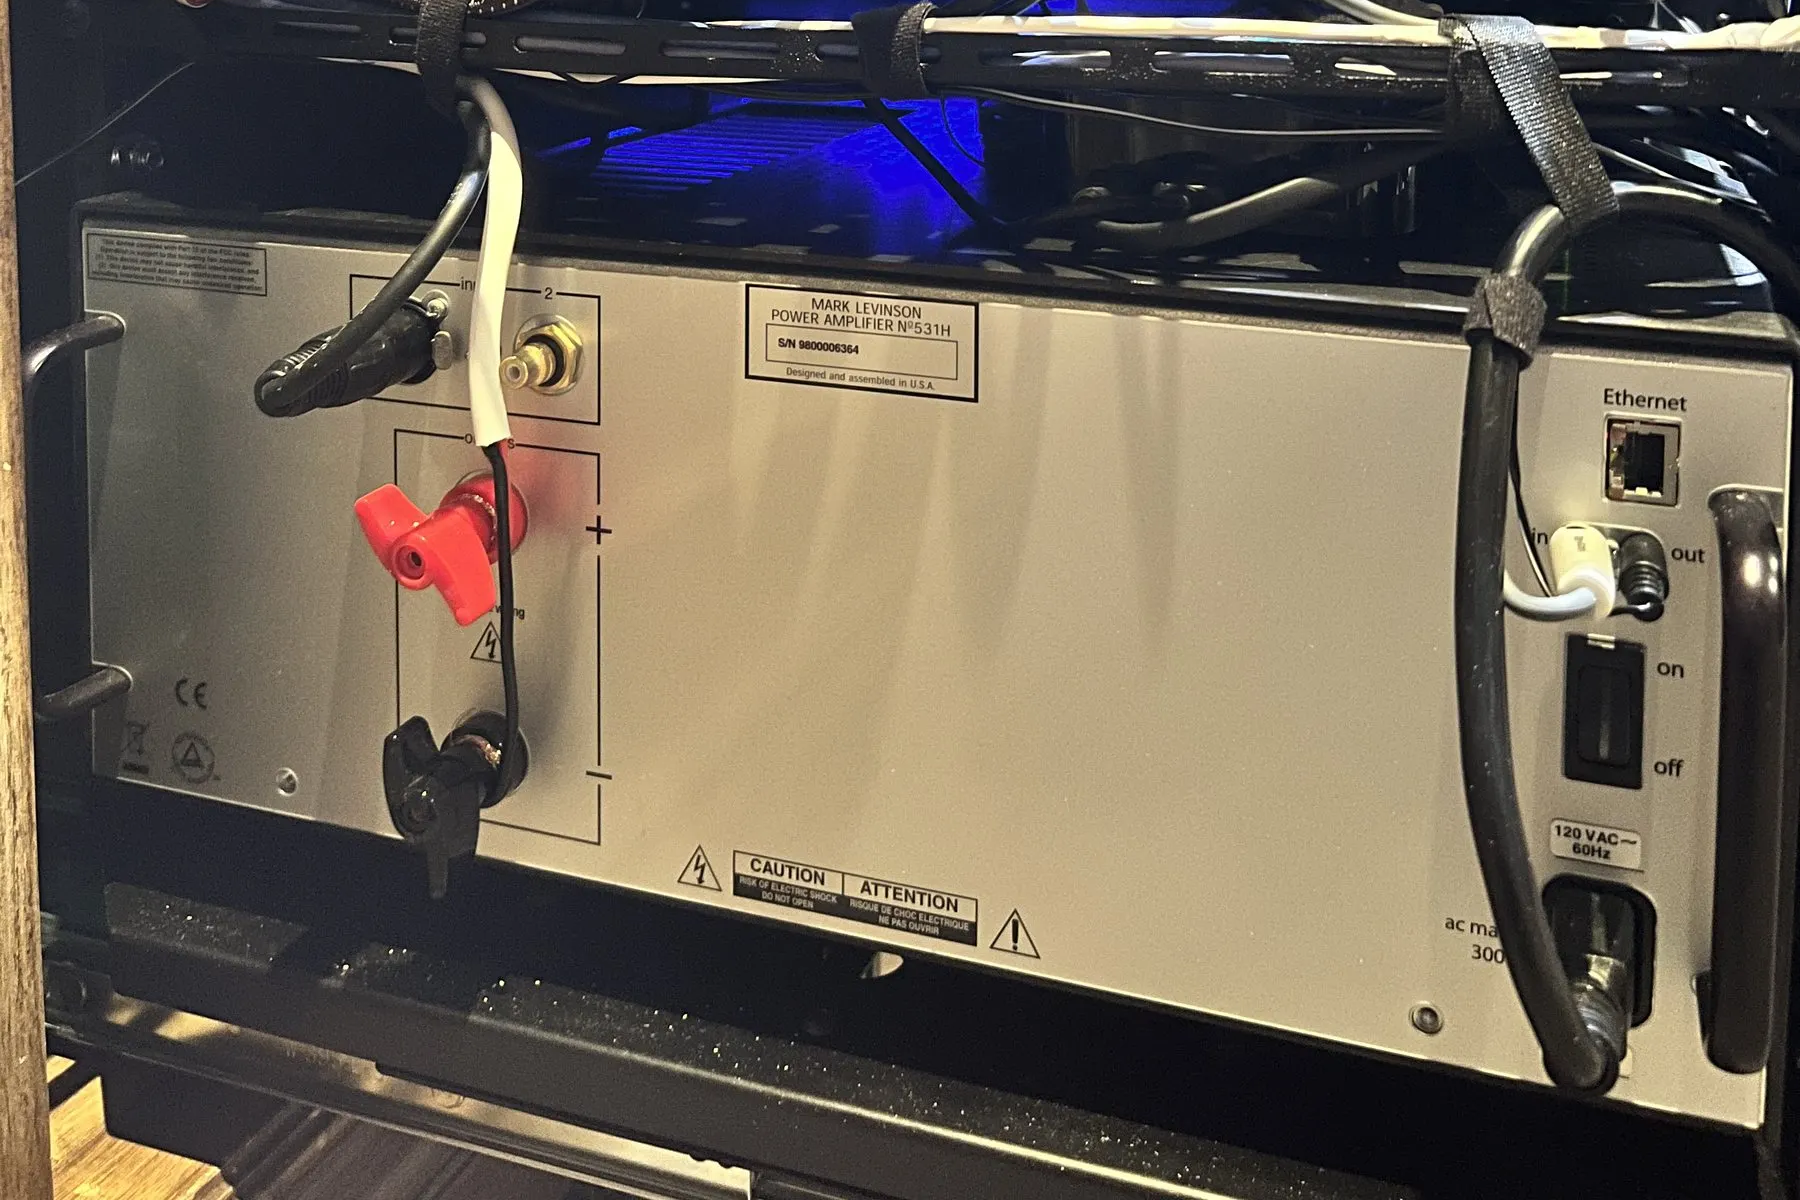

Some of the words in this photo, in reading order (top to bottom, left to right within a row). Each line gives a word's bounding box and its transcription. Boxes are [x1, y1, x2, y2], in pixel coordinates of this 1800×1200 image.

[544, 287, 553, 300] 2
[811, 298, 850, 314] MARK
[855, 301, 922, 319] LEVINSON
[771, 309, 819, 325] POWER
[824, 313, 894, 332] AMPLIFIER
[778, 337, 796, 350] S/N
[798, 339, 860, 355] 9800006364
[786, 366, 827, 381] Designed
[829, 370, 846, 382] and
[849, 372, 896, 388] assembled
[898, 377, 908, 388] in
[910, 377, 935, 391] U.S.A.
[1603, 387, 1688, 412] Ethernet
[1671, 547, 1706, 563] out
[1656, 660, 1685, 679] on
[1653, 757, 1685, 777] off
[1554, 824, 1581, 840] 120
[1572, 842, 1611, 860] 60Hz
[750, 858, 825, 886] CAUTION
[740, 875, 757, 888] RISK
[759, 880, 769, 890] OF
[771, 882, 808, 897] ELECTRIC
[810, 890, 838, 904] SHOCK
[860, 880, 958, 913] ATTENTION
[762, 891, 773, 900] DO
[774, 893, 790, 903] NOT
[792, 898, 814, 909] OPEN
[849, 898, 879, 912] RISQUE
[880, 905, 892, 915] DE
[893, 908, 917, 920] CHOC
[919, 912, 969, 932] ELECTRIQUE
[879, 914, 889, 925] NE
[891, 917, 907, 929] PAS
